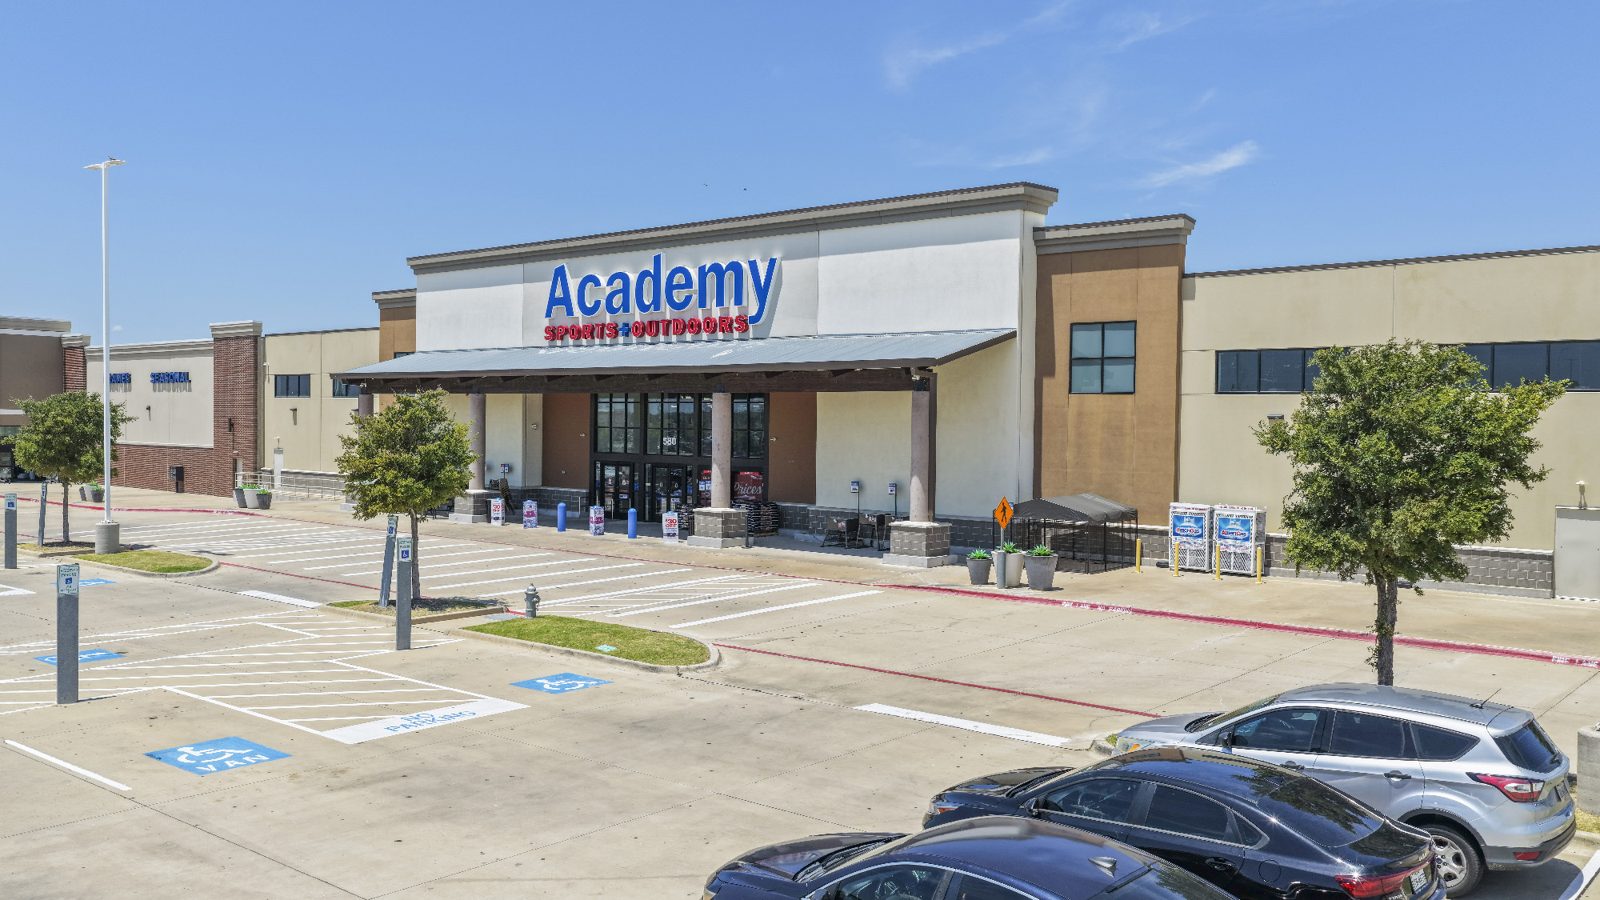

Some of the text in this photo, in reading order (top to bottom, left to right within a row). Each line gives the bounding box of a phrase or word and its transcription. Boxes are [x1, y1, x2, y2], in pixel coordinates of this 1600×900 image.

[545, 253, 778, 325] Academy
[109, 373, 131, 384] AMES
[150, 372, 191, 384] SEASONAL
[663, 437, 677, 446] 580
[384, 711, 476, 731] PARKING
[401, 713, 434, 722] NO
[195, 754, 270, 772] VAN
